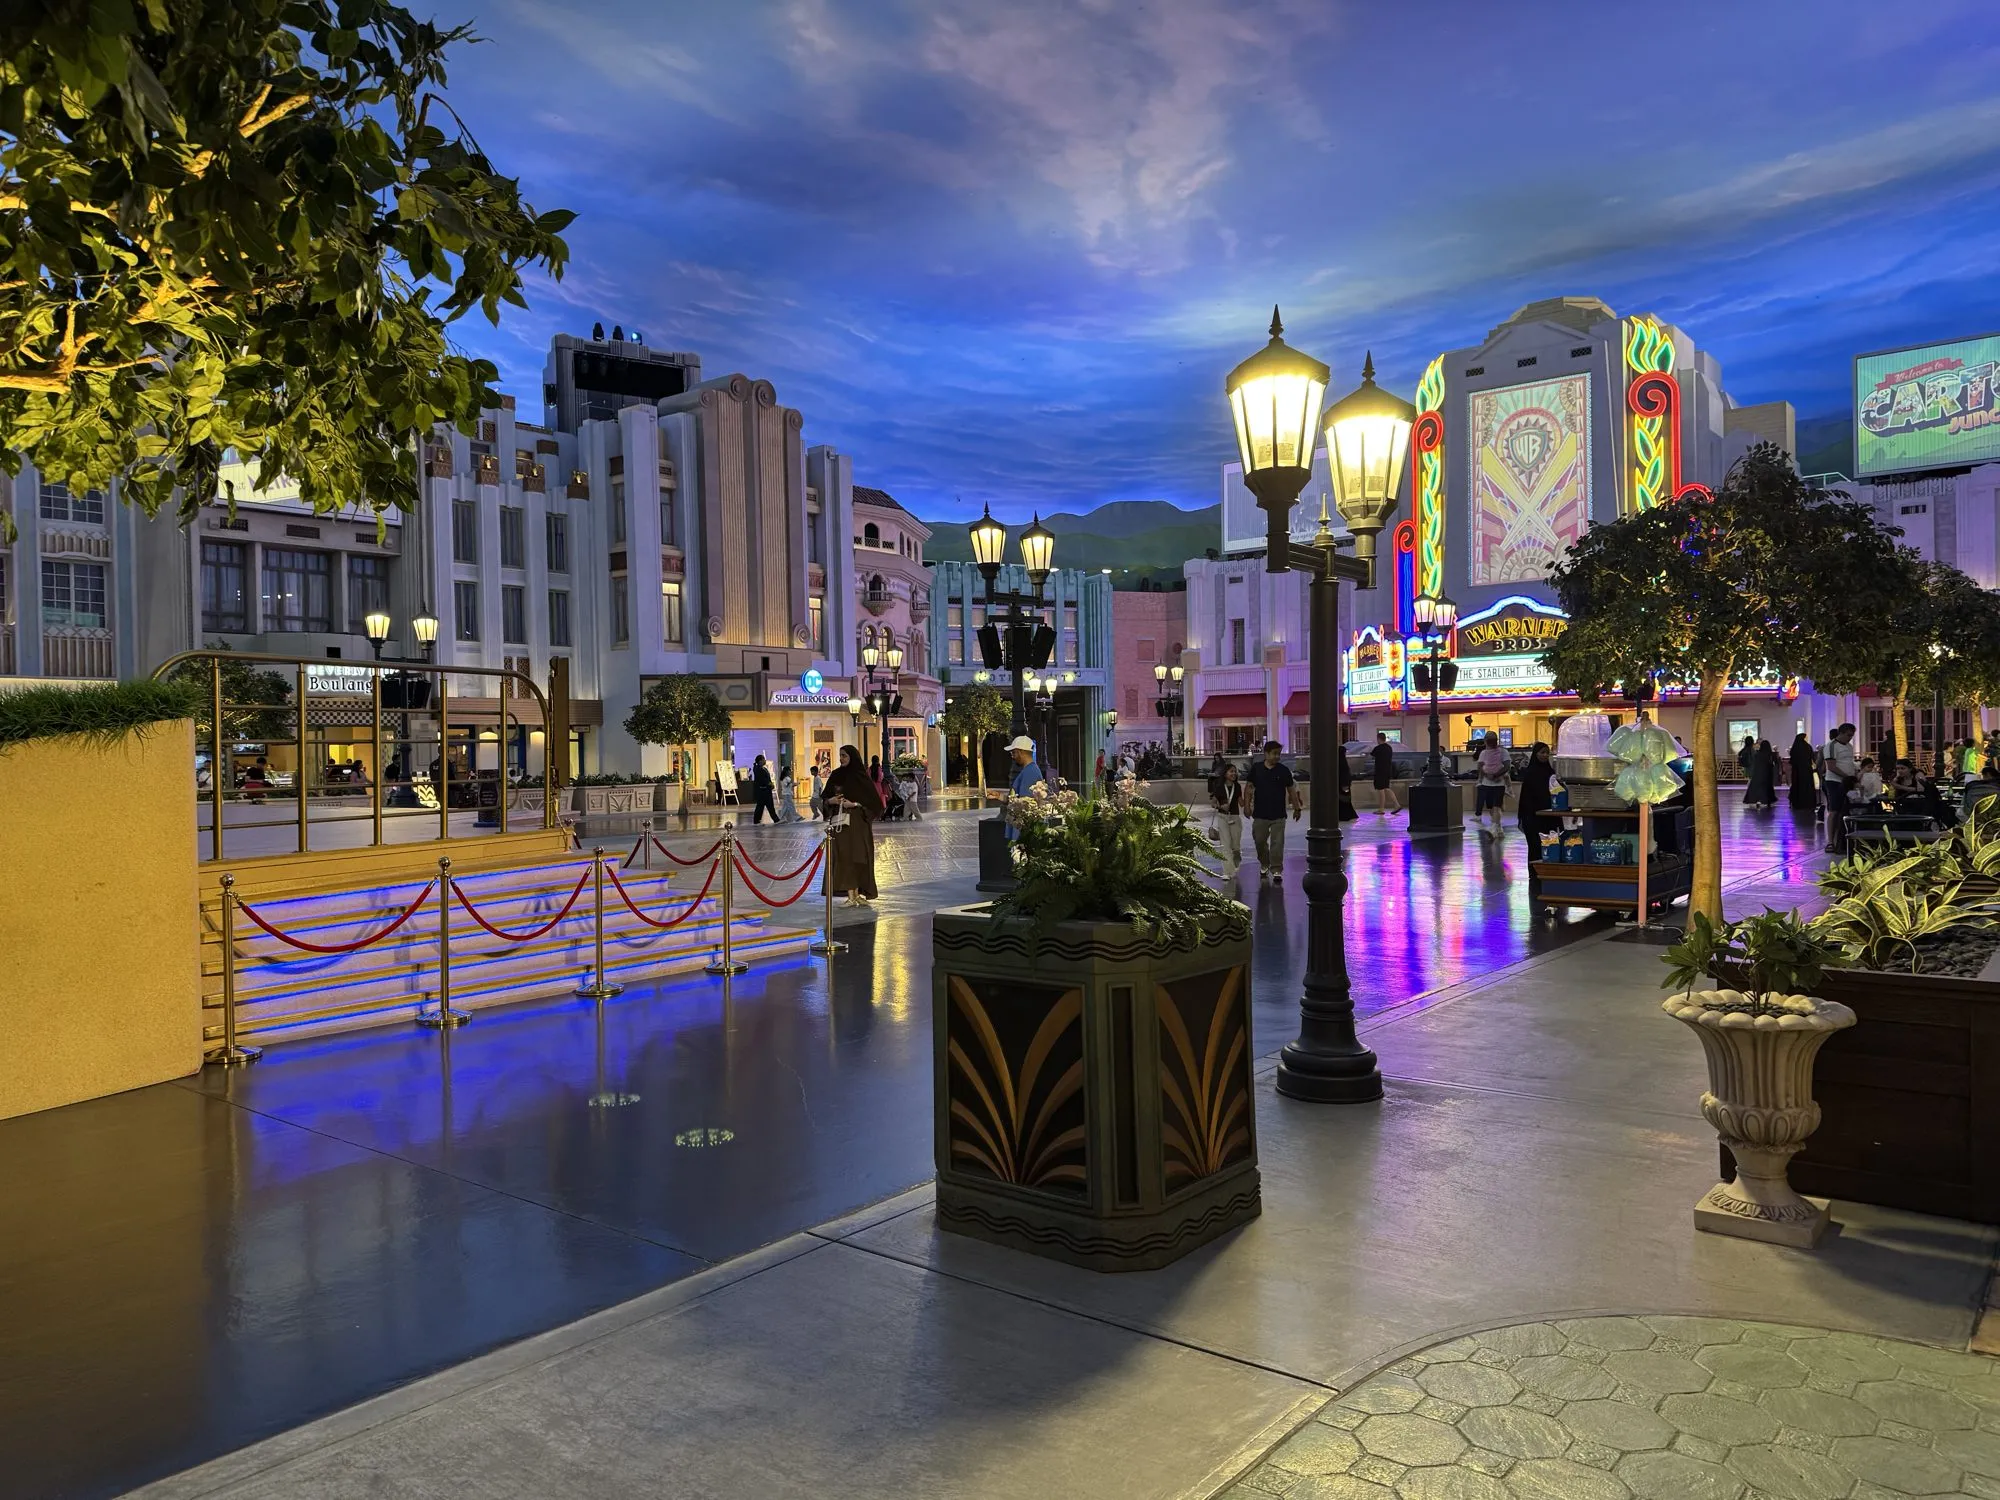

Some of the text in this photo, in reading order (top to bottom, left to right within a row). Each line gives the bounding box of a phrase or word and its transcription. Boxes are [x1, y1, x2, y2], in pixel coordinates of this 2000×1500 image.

[1894, 361, 1945, 383] Welcome to
[1513, 434, 1541, 464] WB
[1493, 637, 1548, 652] BROS.
[1459, 669, 1473, 679] THE
[1477, 666, 1520, 679] STARLIGHT
[806, 675, 822, 688] DC
[775, 694, 849, 704] SUPER HEROES STORE
